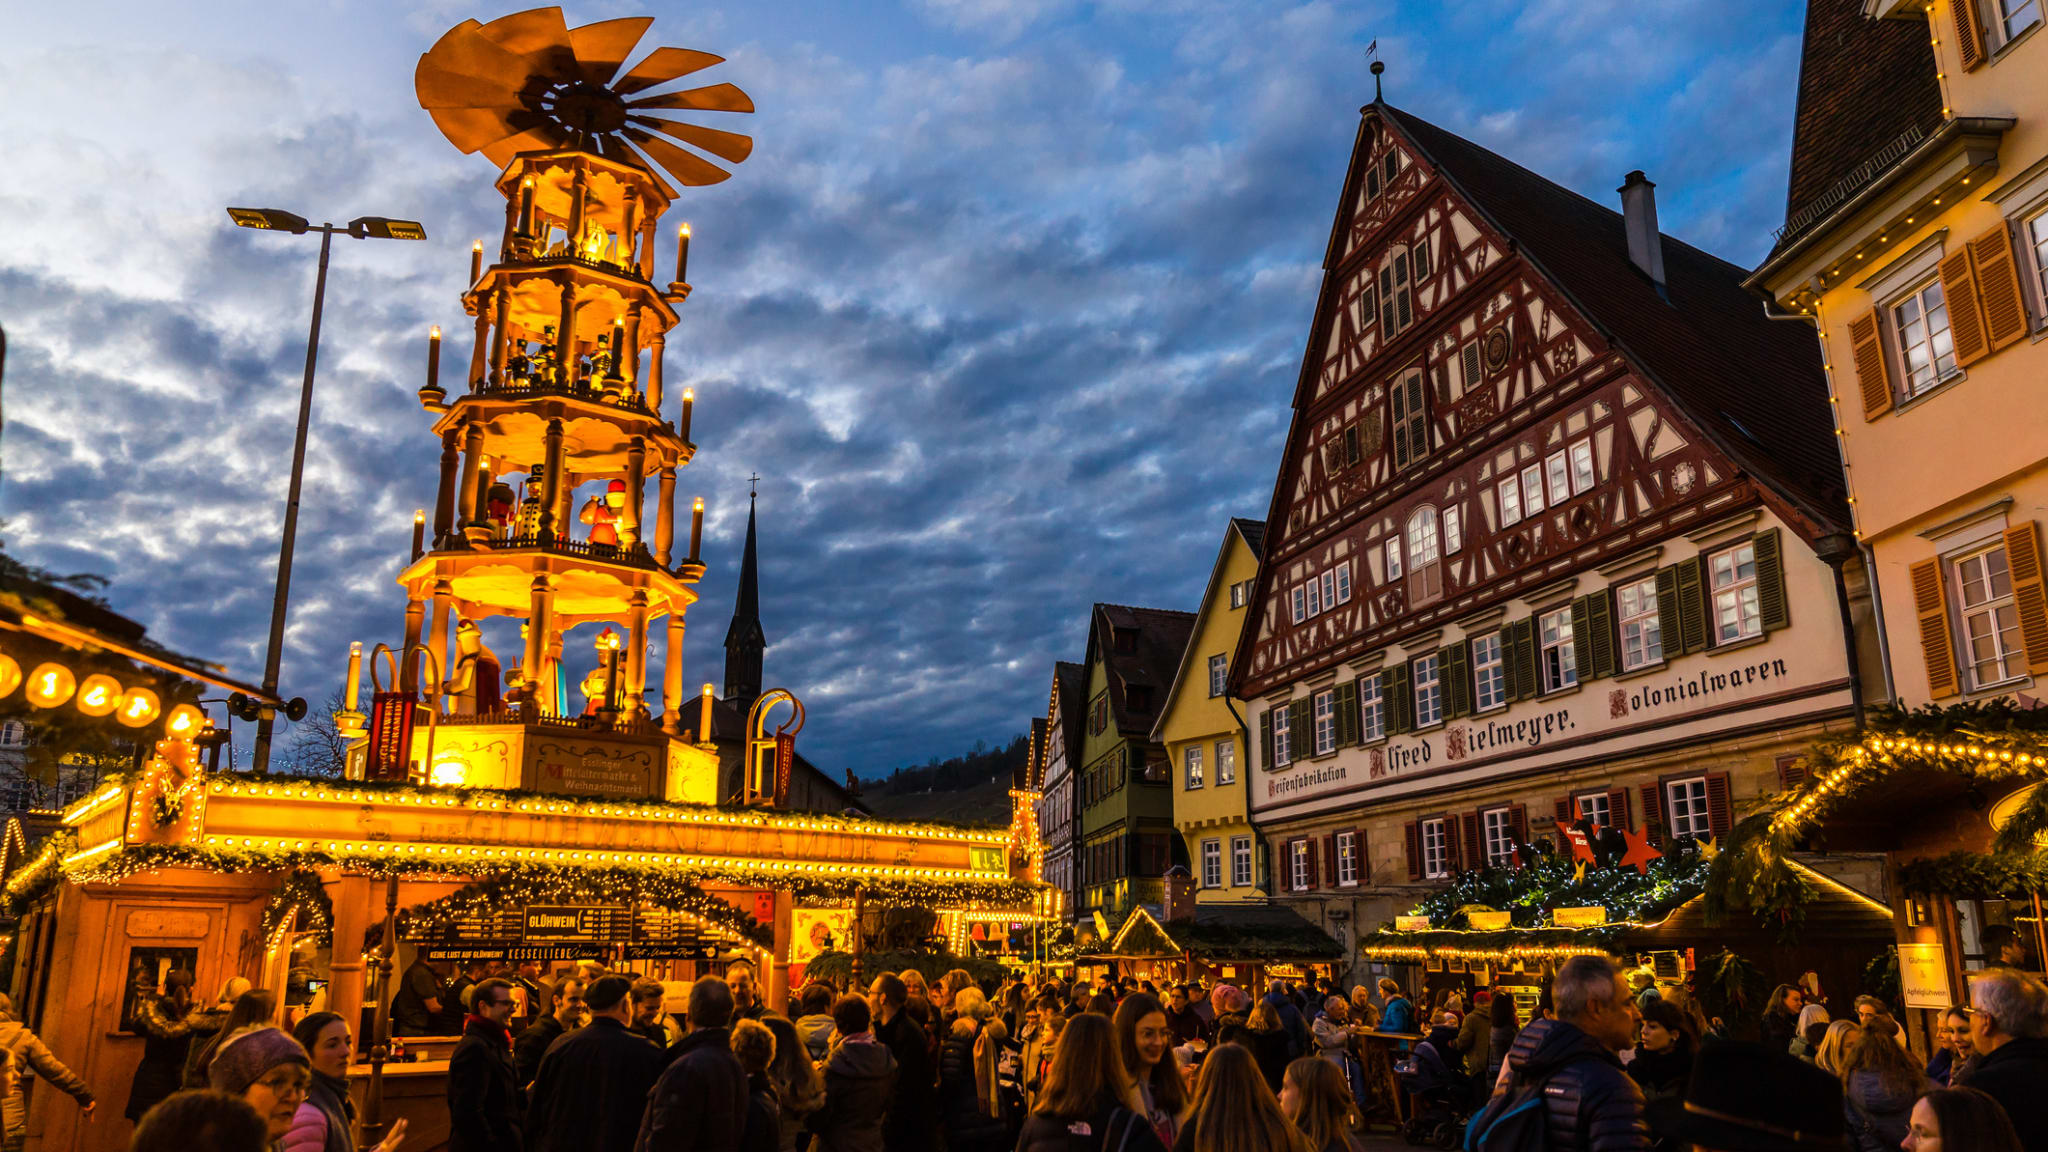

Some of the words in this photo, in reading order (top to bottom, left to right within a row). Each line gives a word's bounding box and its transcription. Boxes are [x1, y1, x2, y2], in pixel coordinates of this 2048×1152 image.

[1369, 739, 1433, 780] Alfred
[1608, 658, 1788, 720] Kolonialwaren
[565, 780, 642, 795] Weihnachtsmarkt
[528, 913, 576, 928] GLÜHWEIN
[429, 951, 446, 959] KEINE
[446, 951, 460, 959] LUST
[461, 951, 472, 959] AUF
